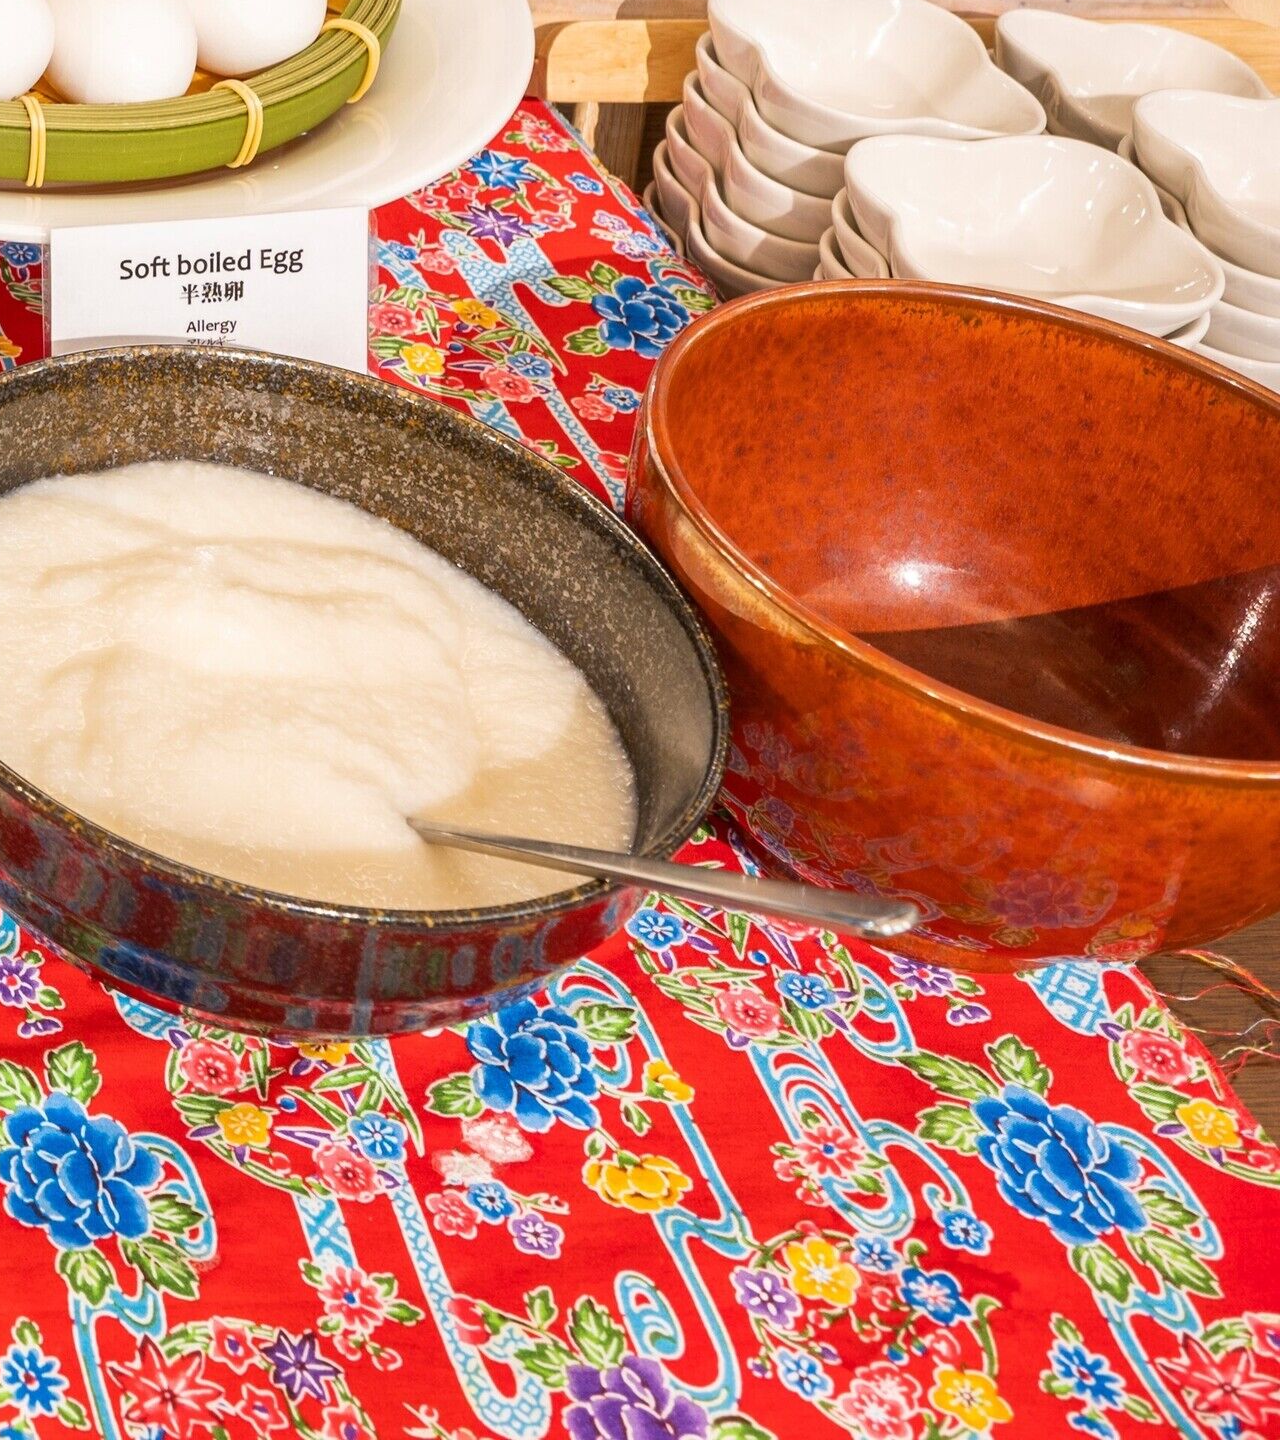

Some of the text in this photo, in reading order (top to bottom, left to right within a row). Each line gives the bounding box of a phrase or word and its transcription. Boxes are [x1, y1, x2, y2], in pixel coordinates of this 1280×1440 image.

[120, 247, 303, 279] Soft boiled Egg
[180, 281, 244, 305] 半熟卵
[186, 319, 237, 333] Allergy
